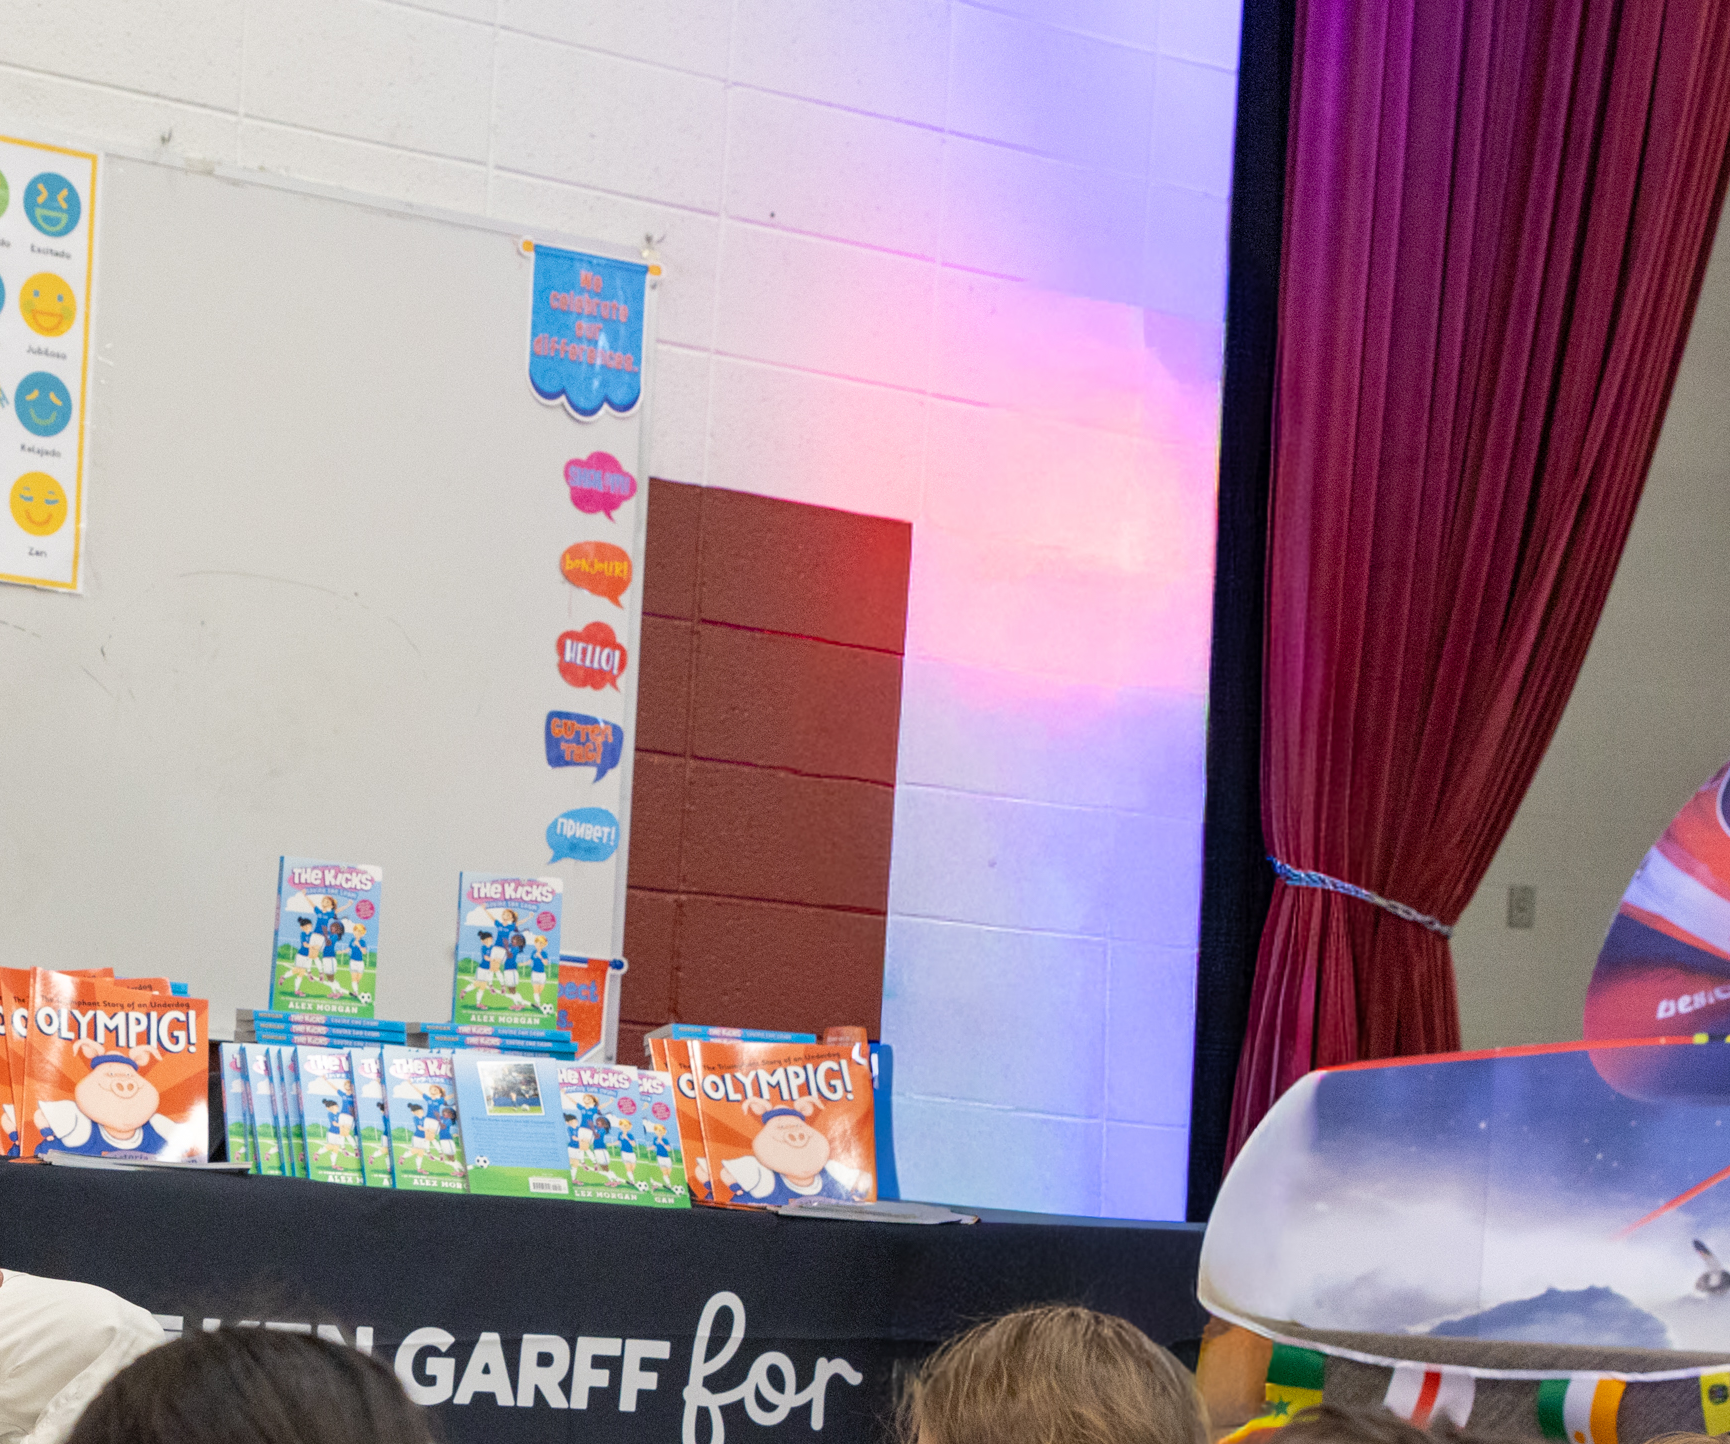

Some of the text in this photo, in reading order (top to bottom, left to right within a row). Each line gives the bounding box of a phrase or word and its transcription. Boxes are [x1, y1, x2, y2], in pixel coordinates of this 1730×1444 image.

[30, 243, 71, 260] Excitado
[27, 345, 67, 360] Jubiloso
[28, 546, 47, 558] Zen
[564, 638, 620, 675] HELLO!
[103, 1000, 125, 1009] Story
[127, 1000, 135, 1009] of
[150, 1001, 190, 1010] Underdog
[288, 1001, 313, 1011] ALEX
[316, 1003, 358, 1014] MORGAN
[470, 1014, 540, 1025] ALEX MORGAN
[35, 1006, 196, 1053] OLYMPIG!
[804, 1052, 840, 1060] Underdog
[702, 1059, 855, 1101] OLYMPIG!
[327, 1175, 353, 1184] ALEX
[413, 1178, 438, 1188] ALEX
[575, 1190, 637, 1201] LEX MORGAN
[654, 1196, 674, 1204] GAN
[395, 1326, 670, 1412] GARFF
